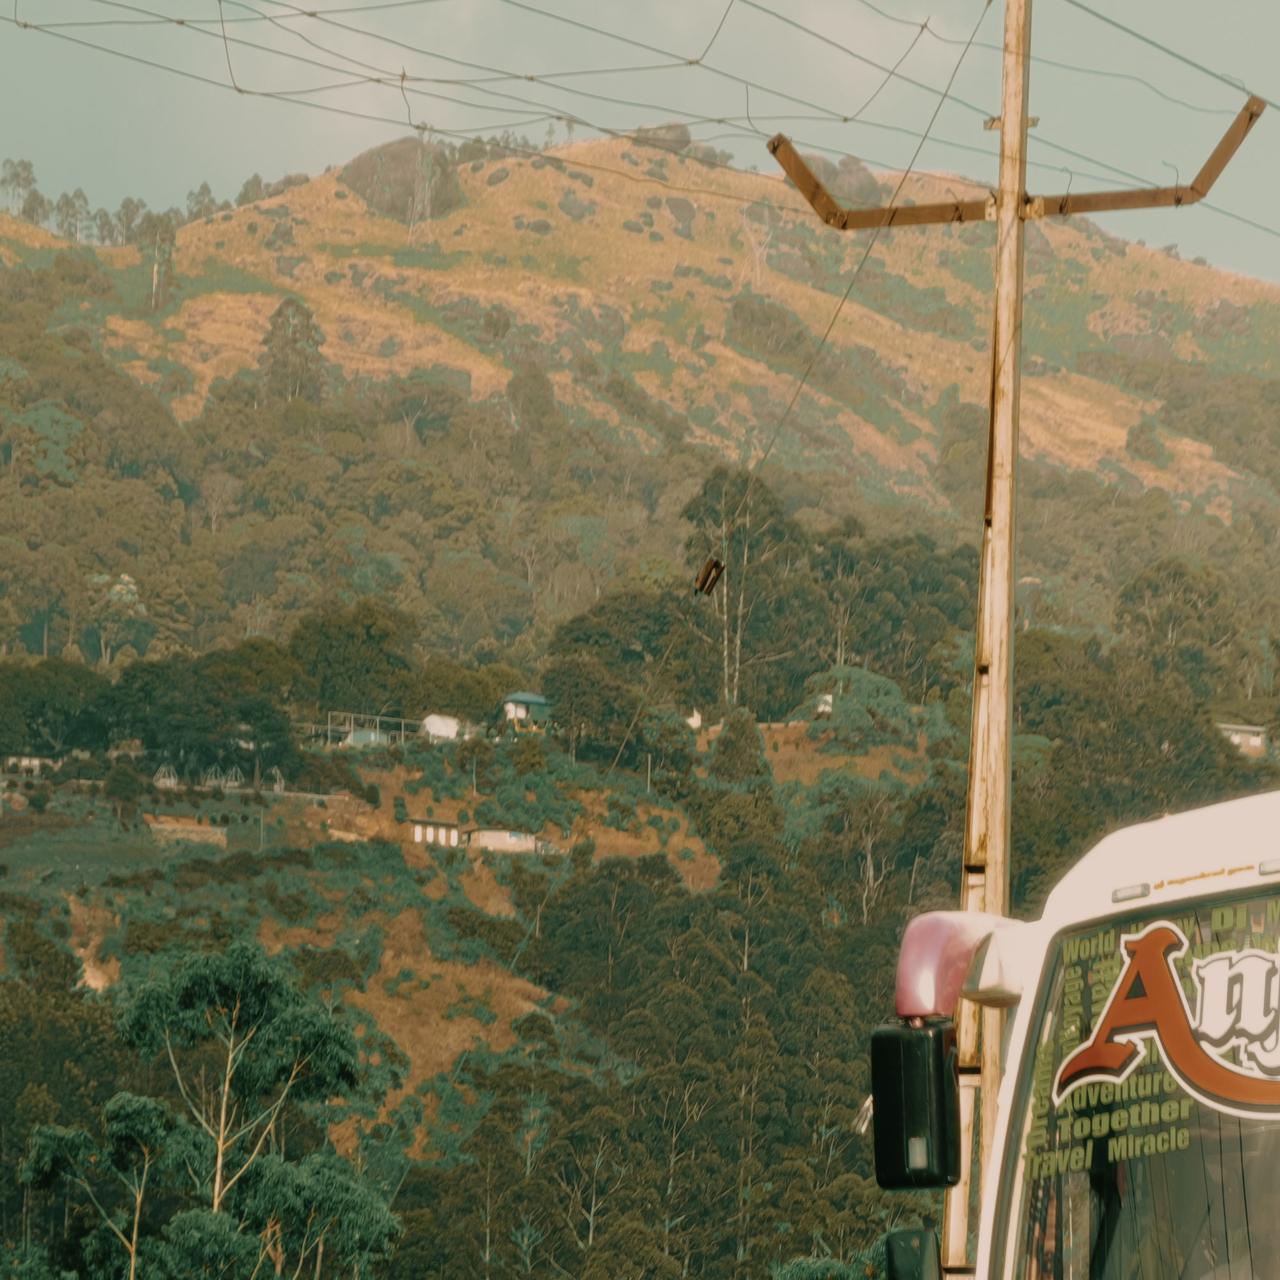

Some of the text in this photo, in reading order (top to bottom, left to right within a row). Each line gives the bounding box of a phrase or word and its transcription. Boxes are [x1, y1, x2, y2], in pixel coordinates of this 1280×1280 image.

[1063, 928, 1116, 965] World
[1057, 1070, 1178, 1114] Adventure
[1057, 1098, 1194, 1143] Together
[1023, 1139, 1093, 1183] Travel
[1108, 1126, 1190, 1163] Miracle
